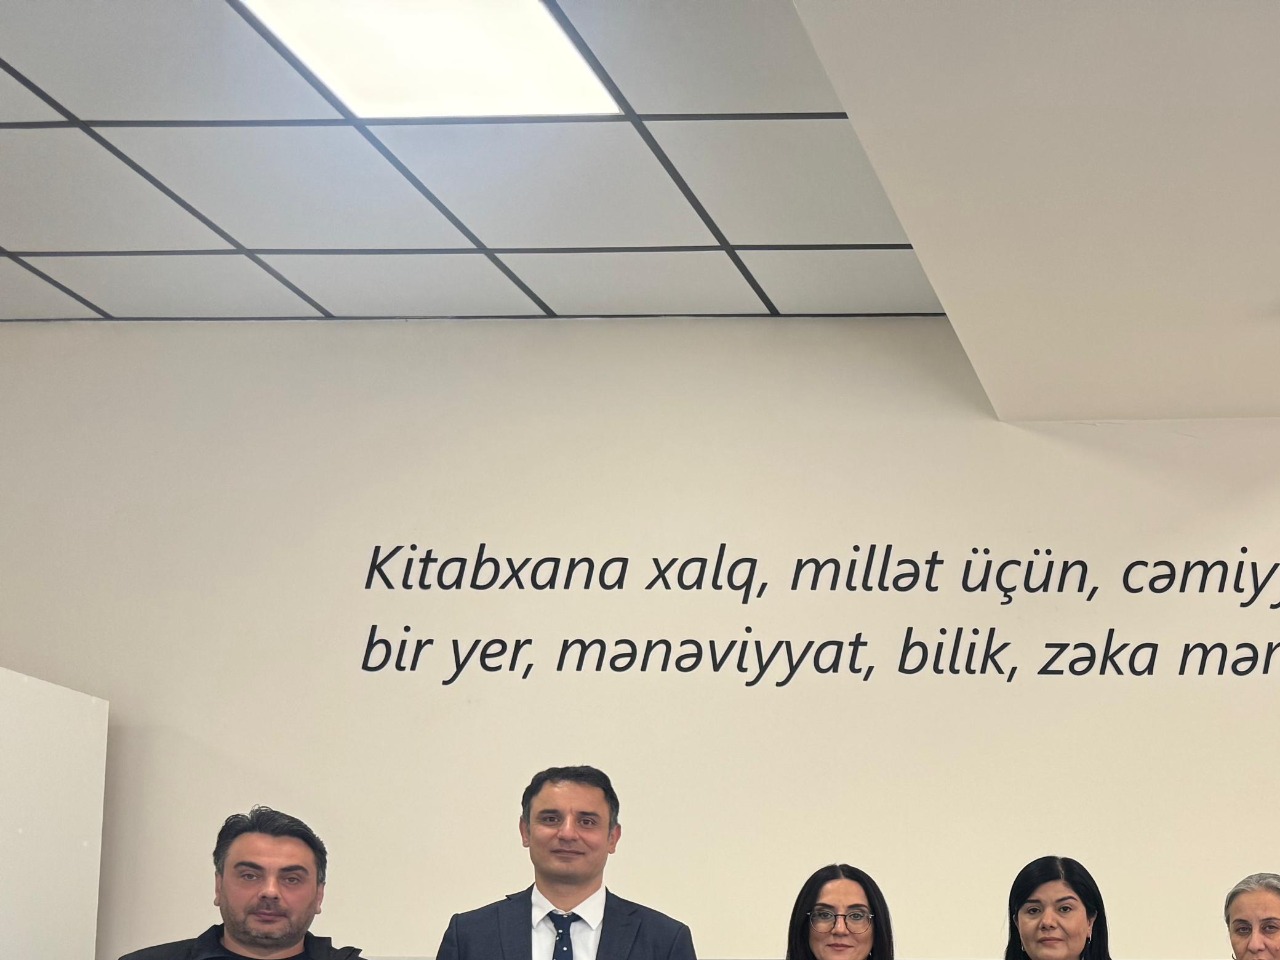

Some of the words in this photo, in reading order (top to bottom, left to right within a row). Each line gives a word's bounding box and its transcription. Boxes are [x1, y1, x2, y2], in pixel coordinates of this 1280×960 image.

[365, 543, 628, 590] Kitabxana
[645, 543, 767, 604] xalq,
[791, 544, 944, 592] millət
[962, 548, 1098, 605] üçün,
[361, 625, 434, 672] bir
[442, 638, 534, 685] yer,
[557, 626, 874, 687] mənəviyyat,
[898, 627, 1017, 682] bilik,
[1037, 628, 1158, 676] zəka
